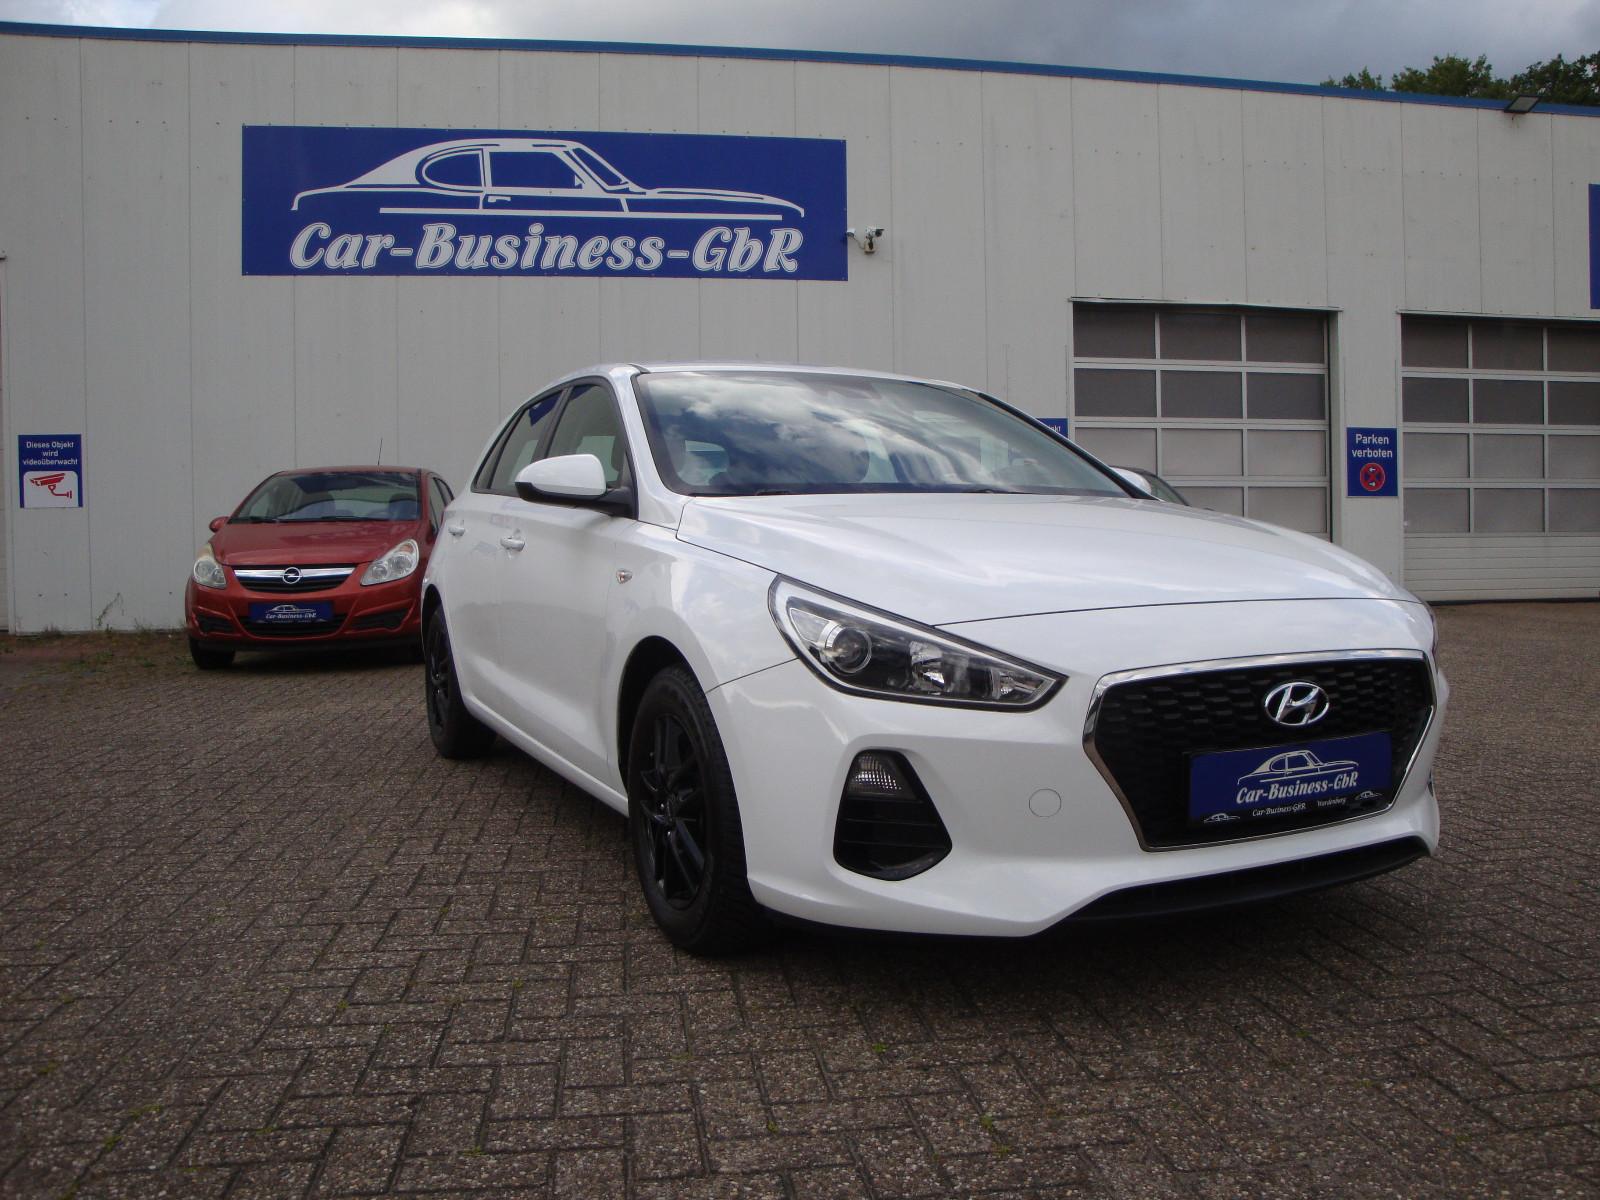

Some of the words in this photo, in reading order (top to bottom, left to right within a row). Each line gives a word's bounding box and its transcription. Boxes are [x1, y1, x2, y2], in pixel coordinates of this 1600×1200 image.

[290, 221, 804, 273] Car-Business-GbR
[1355, 433, 1390, 445] Parken
[26, 441, 50, 449] Dieses
[51, 441, 74, 450] Objekt
[1351, 448, 1393, 458] verboten
[23, 458, 78, 466] videoüberwacht
[1236, 771, 1359, 805] Car-Business-GbR
